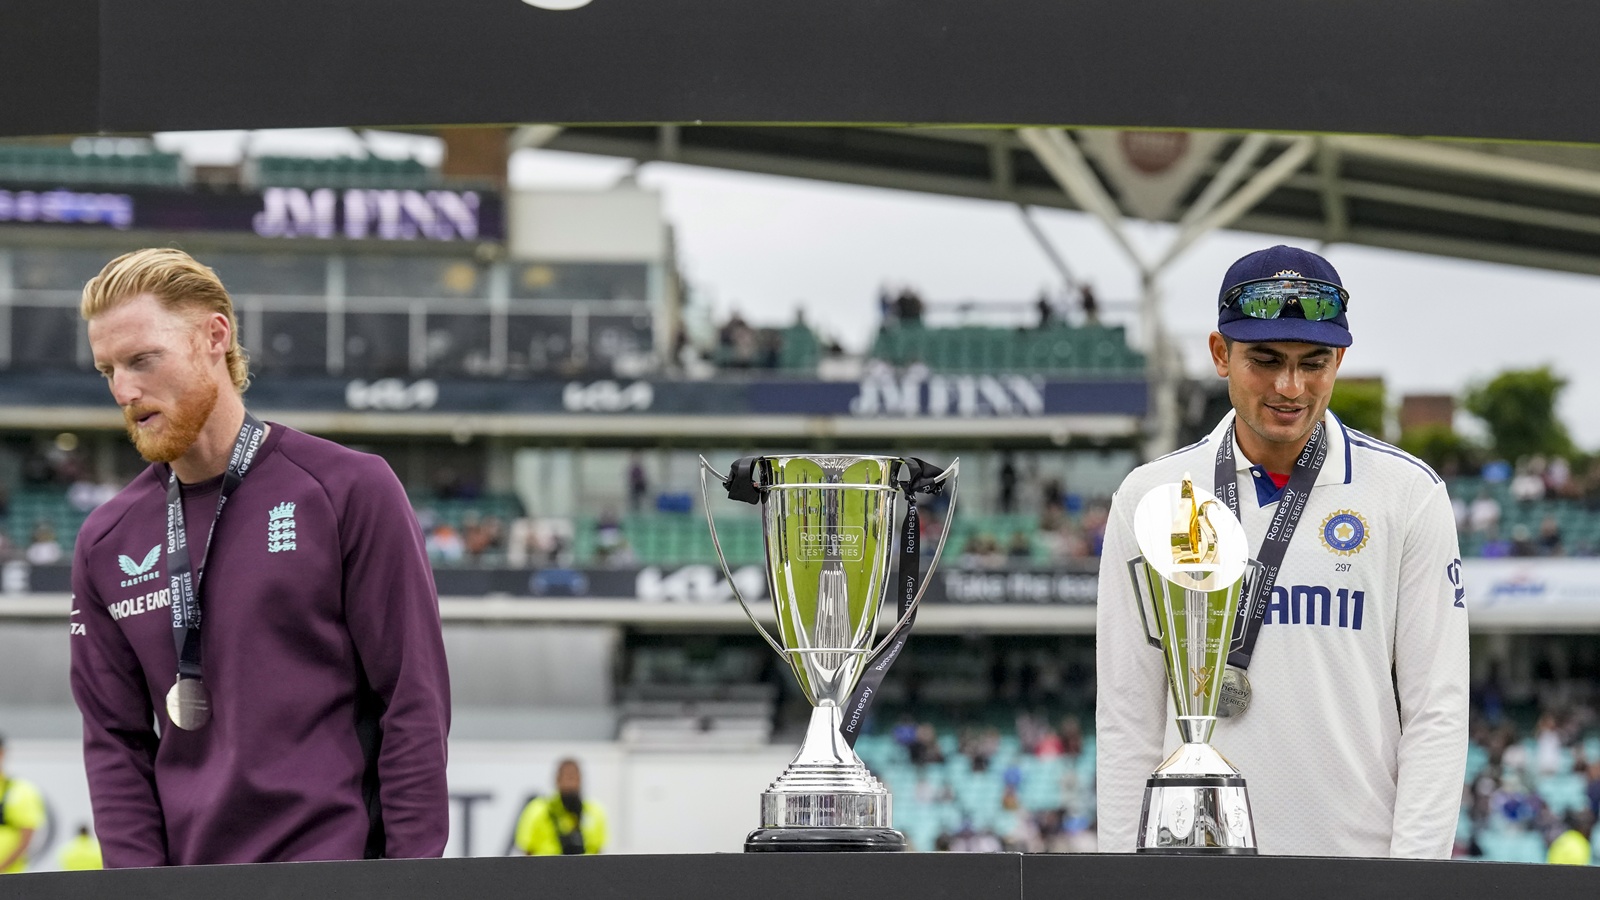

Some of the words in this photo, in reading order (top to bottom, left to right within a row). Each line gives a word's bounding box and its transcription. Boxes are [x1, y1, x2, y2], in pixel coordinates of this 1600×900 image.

[253, 187, 336, 239] JM
[343, 188, 480, 241] FINN
[237, 427, 263, 477] Rothesay
[238, 423, 251, 443] TEST
[1297, 421, 1321, 467] Rothesa
[228, 442, 243, 471] SERIES
[1312, 451, 1325, 470] TEST
[167, 503, 176, 554] Rothesay
[1266, 488, 1296, 541] Rothesay
[1281, 522, 1295, 543] TEST
[1291, 492, 1308, 521] SERIES
[178, 527, 187, 550] TEST
[800, 531, 860, 544] Rothesay
[801, 548, 825, 557] TEST
[826, 548, 859, 557] SERIES
[120, 570, 160, 588] CASTORE
[1335, 562, 1352, 572] 297
[146, 588, 171, 611] EART
[171, 575, 184, 628] Rothesay
[184, 571, 194, 602] SERIES
[904, 575, 916, 625] Rthesay
[1254, 598, 1267, 619] TEST
[1262, 566, 1278, 596] SERIES
[845, 686, 873, 733] Rothesay
